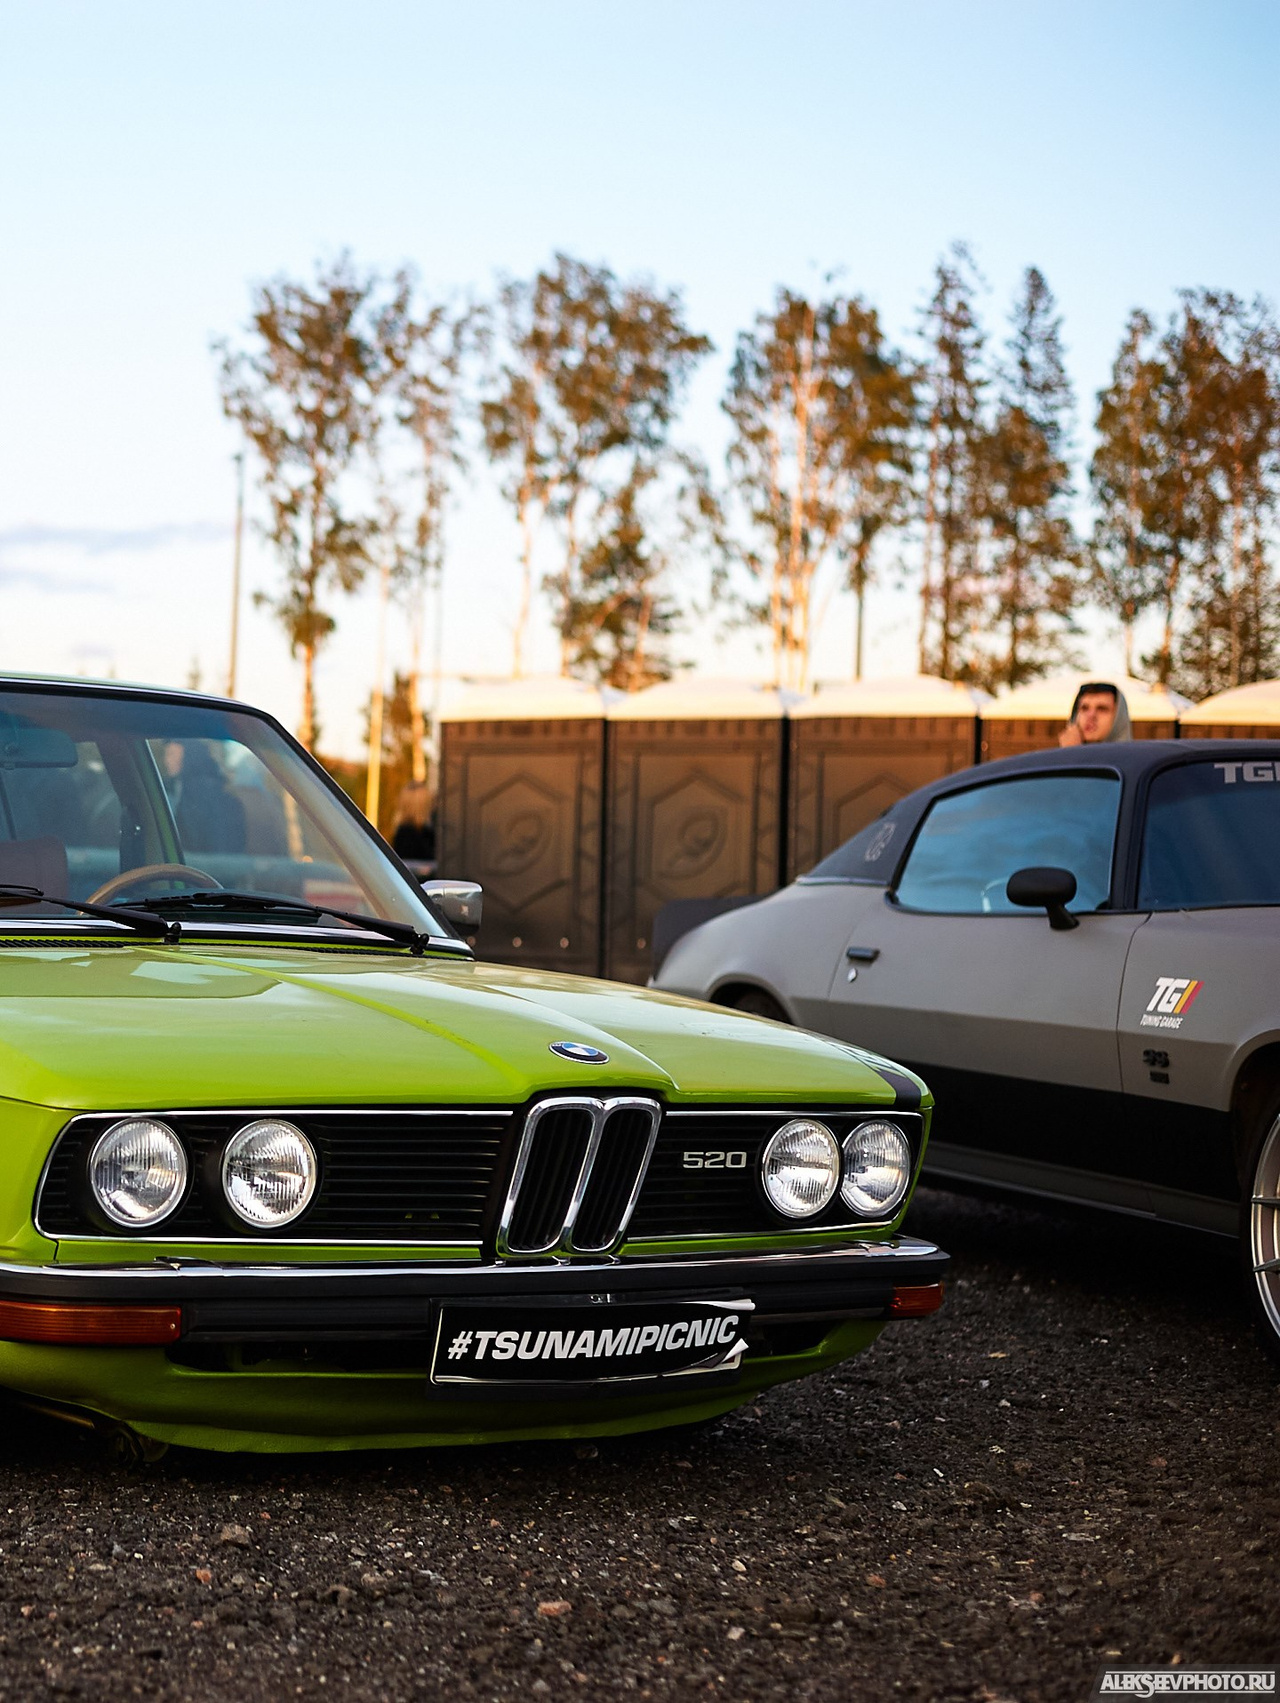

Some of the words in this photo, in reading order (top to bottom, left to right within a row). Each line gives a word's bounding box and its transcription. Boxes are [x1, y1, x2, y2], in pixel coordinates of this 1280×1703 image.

[1140, 1013, 1162, 1027] TUNING
[1159, 1015, 1183, 1029] GARAGE
[683, 1151, 747, 1169] 520
[448, 1315, 740, 1360] #TSUNAMIPICNIC
